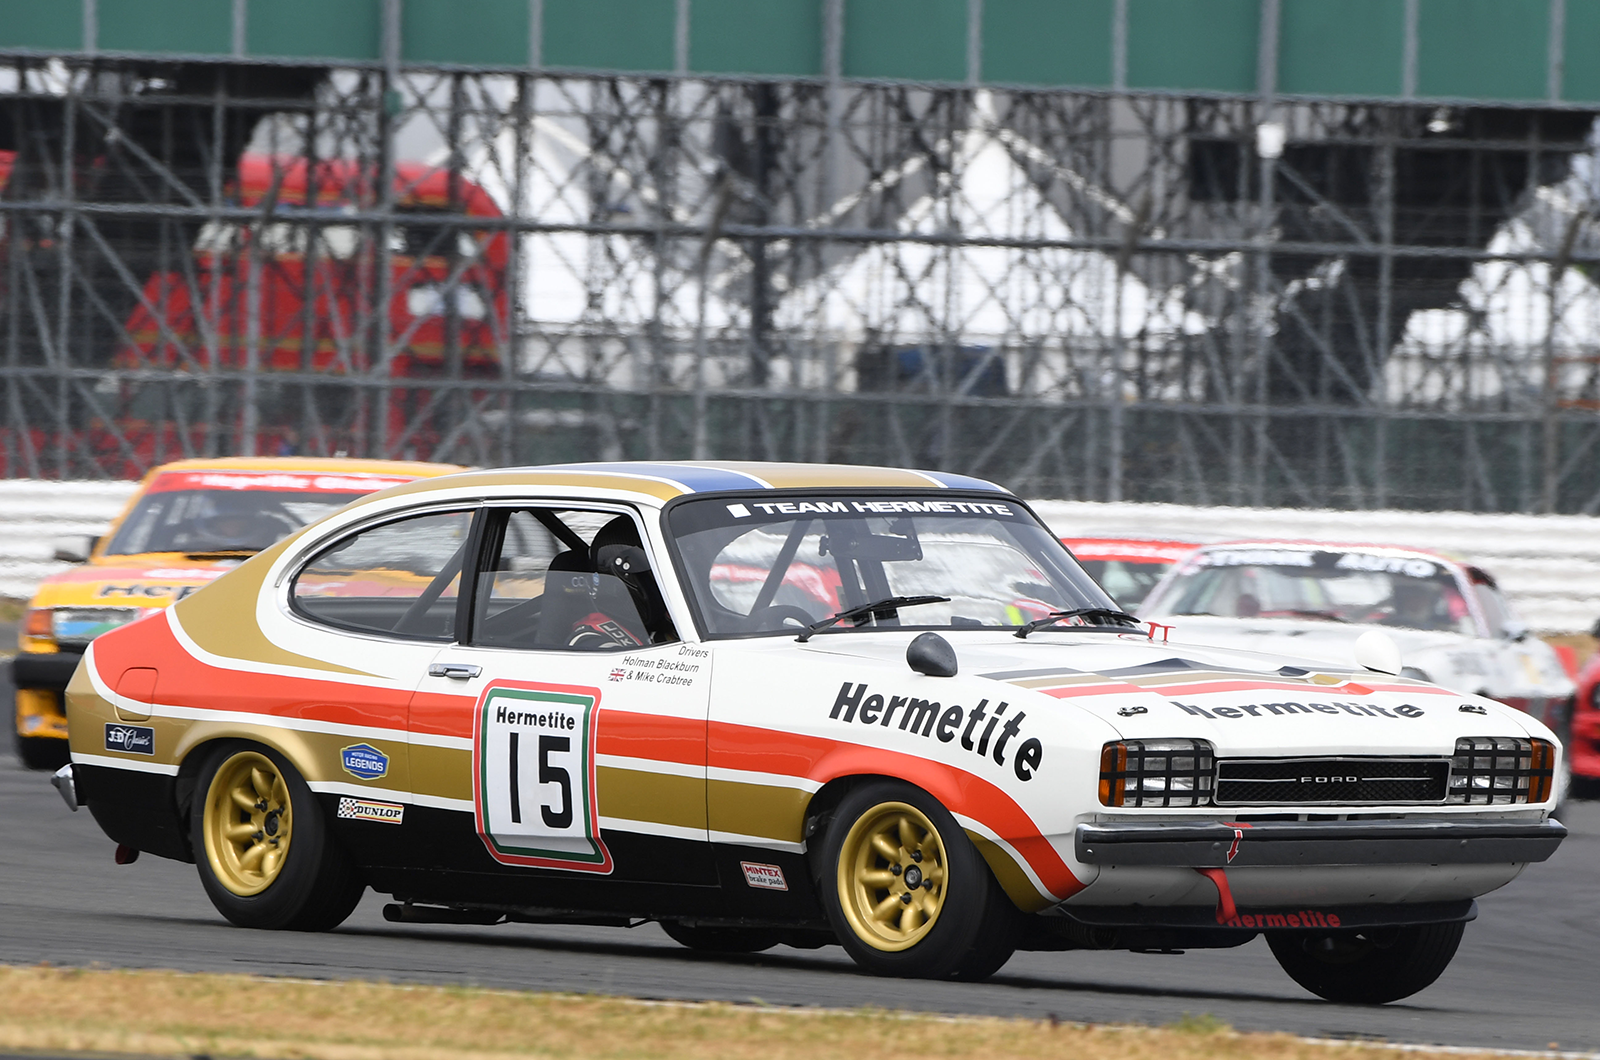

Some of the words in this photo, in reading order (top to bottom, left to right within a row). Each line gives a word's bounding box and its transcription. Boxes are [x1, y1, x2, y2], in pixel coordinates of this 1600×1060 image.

[753, 502, 849, 514] TEAM
[850, 501, 1014, 516] HERMETITE
[678, 645, 709, 658] Drivers
[622, 656, 655, 668] Holman
[656, 659, 700, 673] Blackburn
[626, 670, 634, 680] &
[635, 671, 655, 683] Mike
[656, 673, 693, 687] Crabtree
[496, 706, 575, 730] Hermetite
[1168, 700, 1425, 719] hermetite
[829, 681, 1043, 782] Hermetite
[346, 757, 383, 771] LEGENDS
[509, 732, 573, 829] 15
[356, 805, 401, 818] DUNLOP
[745, 866, 780, 877] MINTEX
